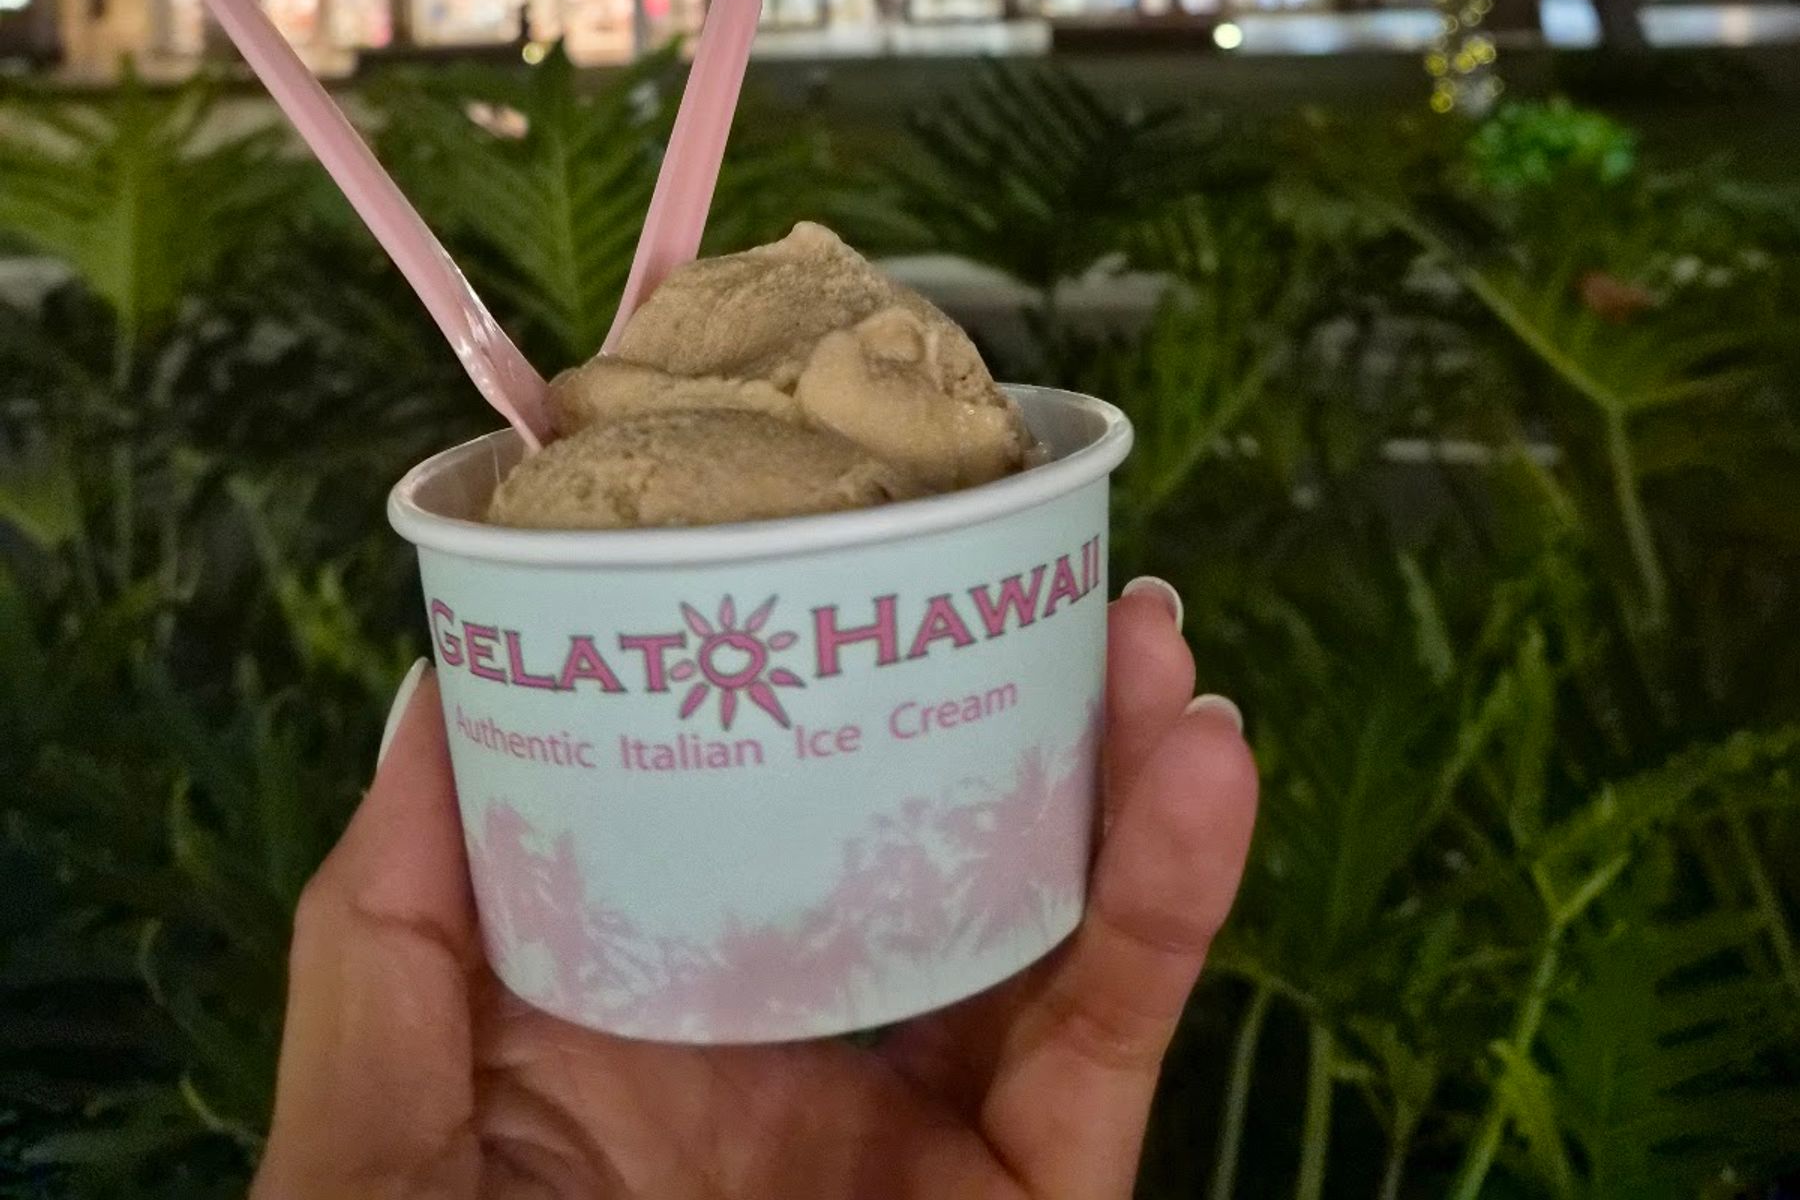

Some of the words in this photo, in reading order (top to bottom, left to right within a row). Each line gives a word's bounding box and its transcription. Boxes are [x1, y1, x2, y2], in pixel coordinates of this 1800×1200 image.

[430, 597, 769, 694] GELATO
[810, 534, 1101, 679] HAWAII
[455, 703, 598, 769] Authentic
[620, 732, 765, 771] Italian
[795, 724, 863, 759] Ice
[887, 681, 1018, 740] Cream
